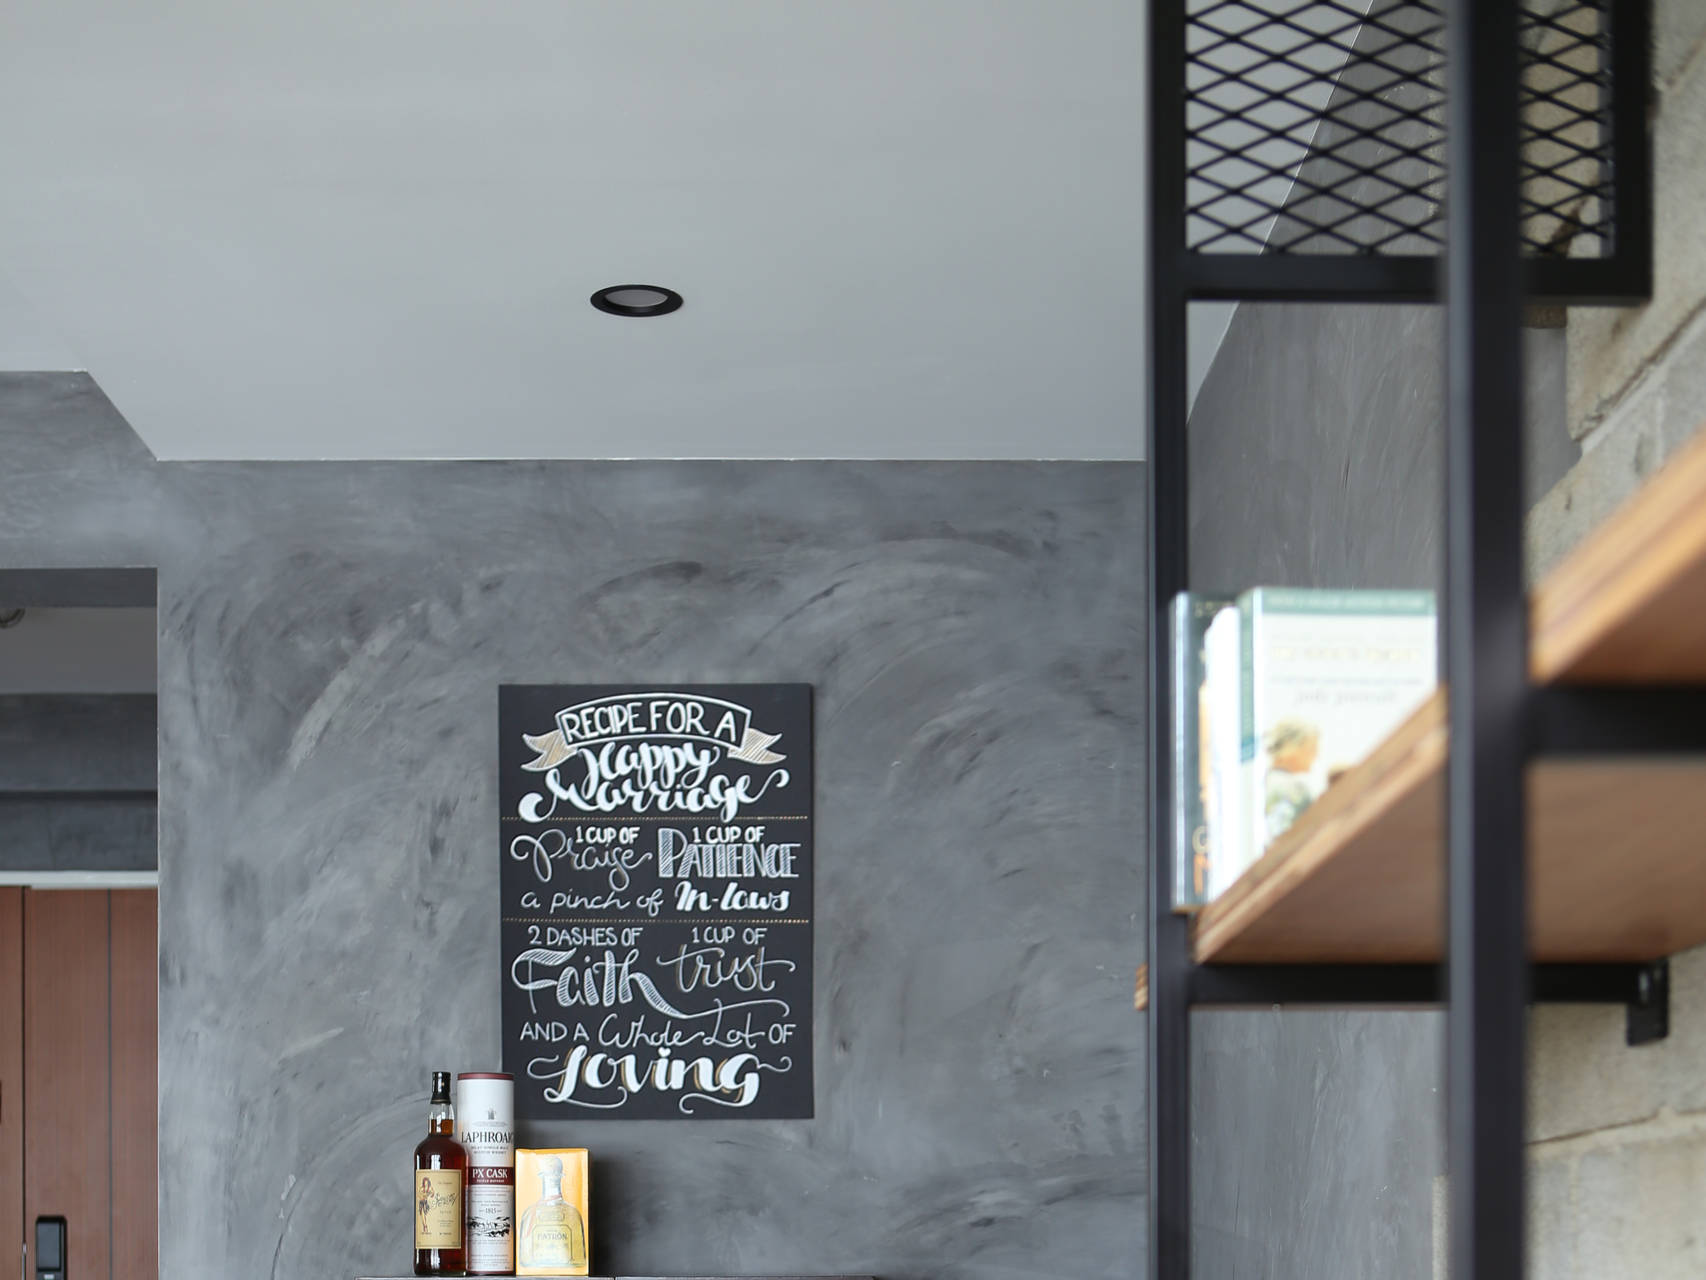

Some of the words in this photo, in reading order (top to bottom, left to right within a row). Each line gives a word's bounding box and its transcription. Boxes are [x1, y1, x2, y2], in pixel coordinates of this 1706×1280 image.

[560, 702, 646, 743] RECIPE
[650, 700, 710, 735] FOR
[714, 711, 737, 742] A
[576, 742, 720, 800] Happy
[518, 768, 790, 823] Marriage
[577, 827, 583, 843] 1
[584, 828, 616, 843] CUP
[622, 827, 640, 844] OF
[658, 827, 801, 879] PATIENCE
[693, 827, 699, 843] 1
[705, 827, 739, 843] CUP
[744, 826, 766, 843] OF
[510, 828, 652, 892] Praise
[521, 891, 541, 909] a
[549, 887, 630, 914] pinch
[636, 888, 664, 917] of
[674, 880, 791, 912] In-laws
[528, 925, 542, 946] 2
[547, 927, 617, 946] DASHES
[621, 927, 644, 946] OF
[692, 927, 699, 942] 1
[704, 926, 735, 943] CUP
[743, 927, 768, 944] OF
[511, 947, 790, 1020] Faith
[520, 1021, 568, 1042] AND
[573, 1023, 590, 1042] A
[599, 1013, 705, 1049] Whole
[702, 998, 766, 1049] Lot
[768, 1023, 797, 1044] OF
[527, 1045, 793, 1114] Loving
[472, 1168, 485, 1178] PX
[486, 1168, 508, 1179] CASK
